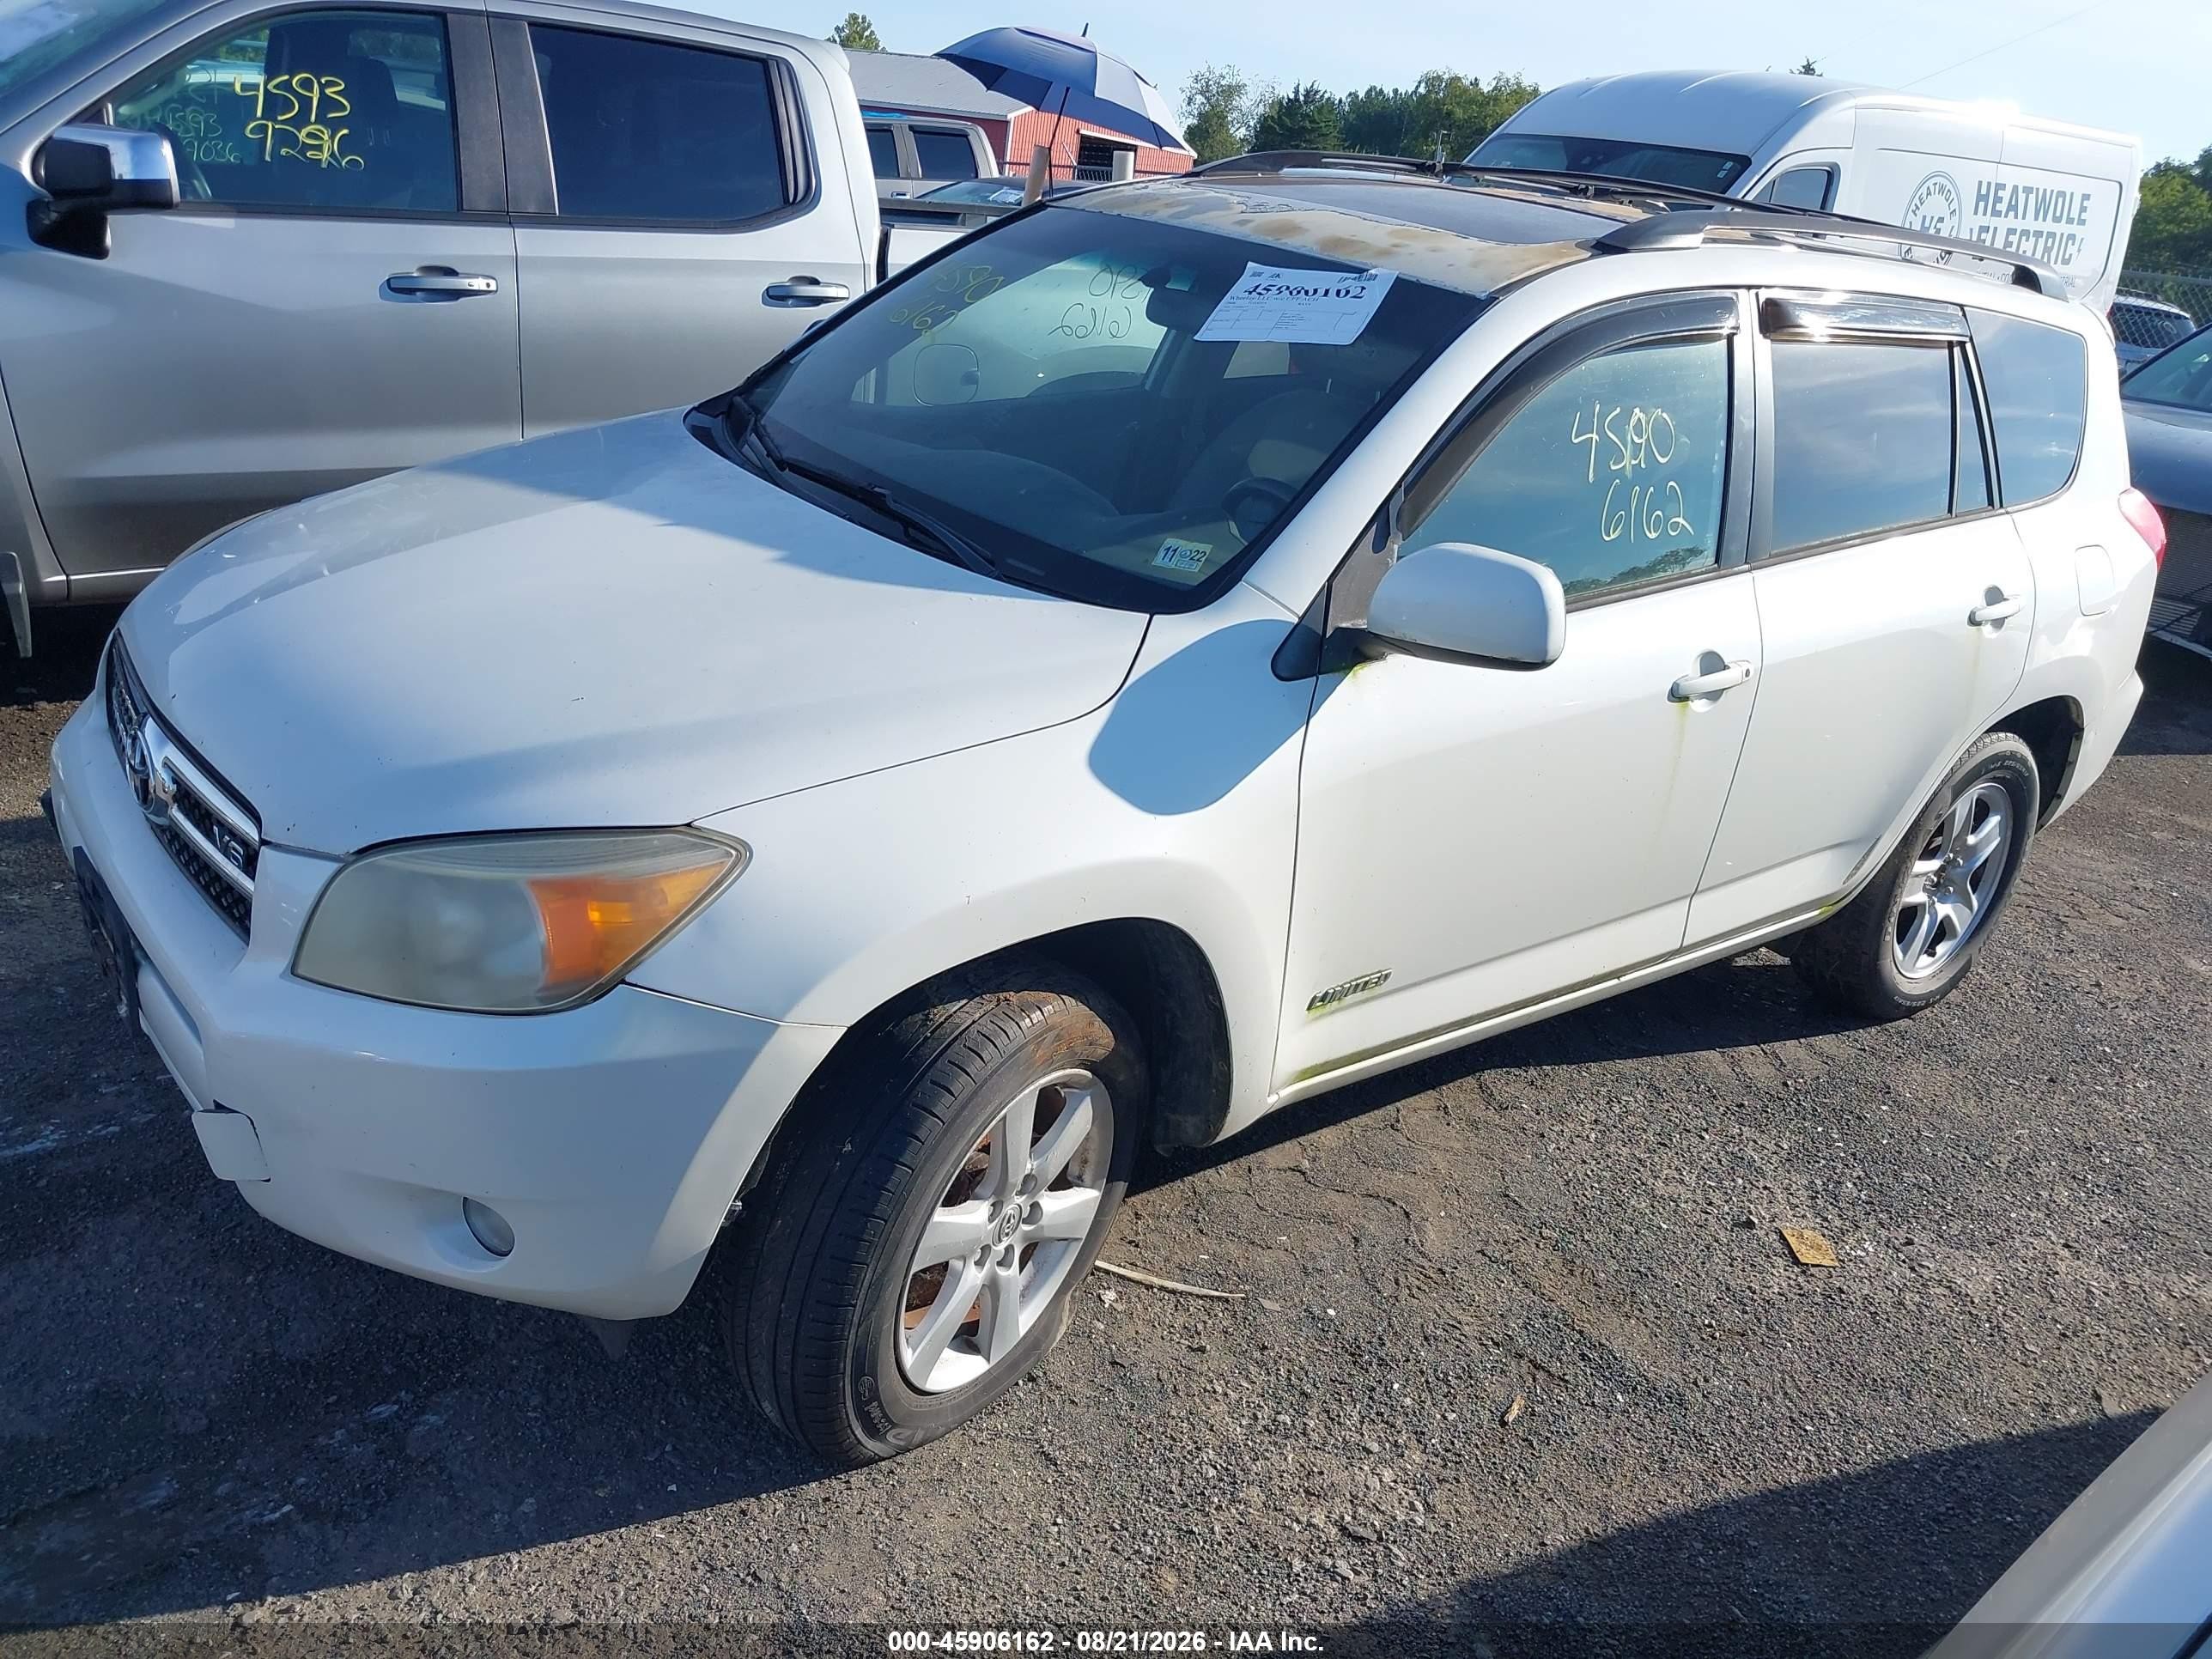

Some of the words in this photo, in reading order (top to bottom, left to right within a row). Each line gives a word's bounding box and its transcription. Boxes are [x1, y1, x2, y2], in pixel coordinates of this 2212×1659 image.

[234, 73, 351, 123] 4593
[1911, 181, 1957, 220] HEATWOLE
[1972, 179, 2091, 227] HEATWOLE
[1601, 479, 1694, 544] 6162
[1161, 544, 1180, 563] 11
[1188, 549, 1206, 562] 22
[212, 824, 244, 870] V6
[1305, 969, 1393, 1012] LIMITED
